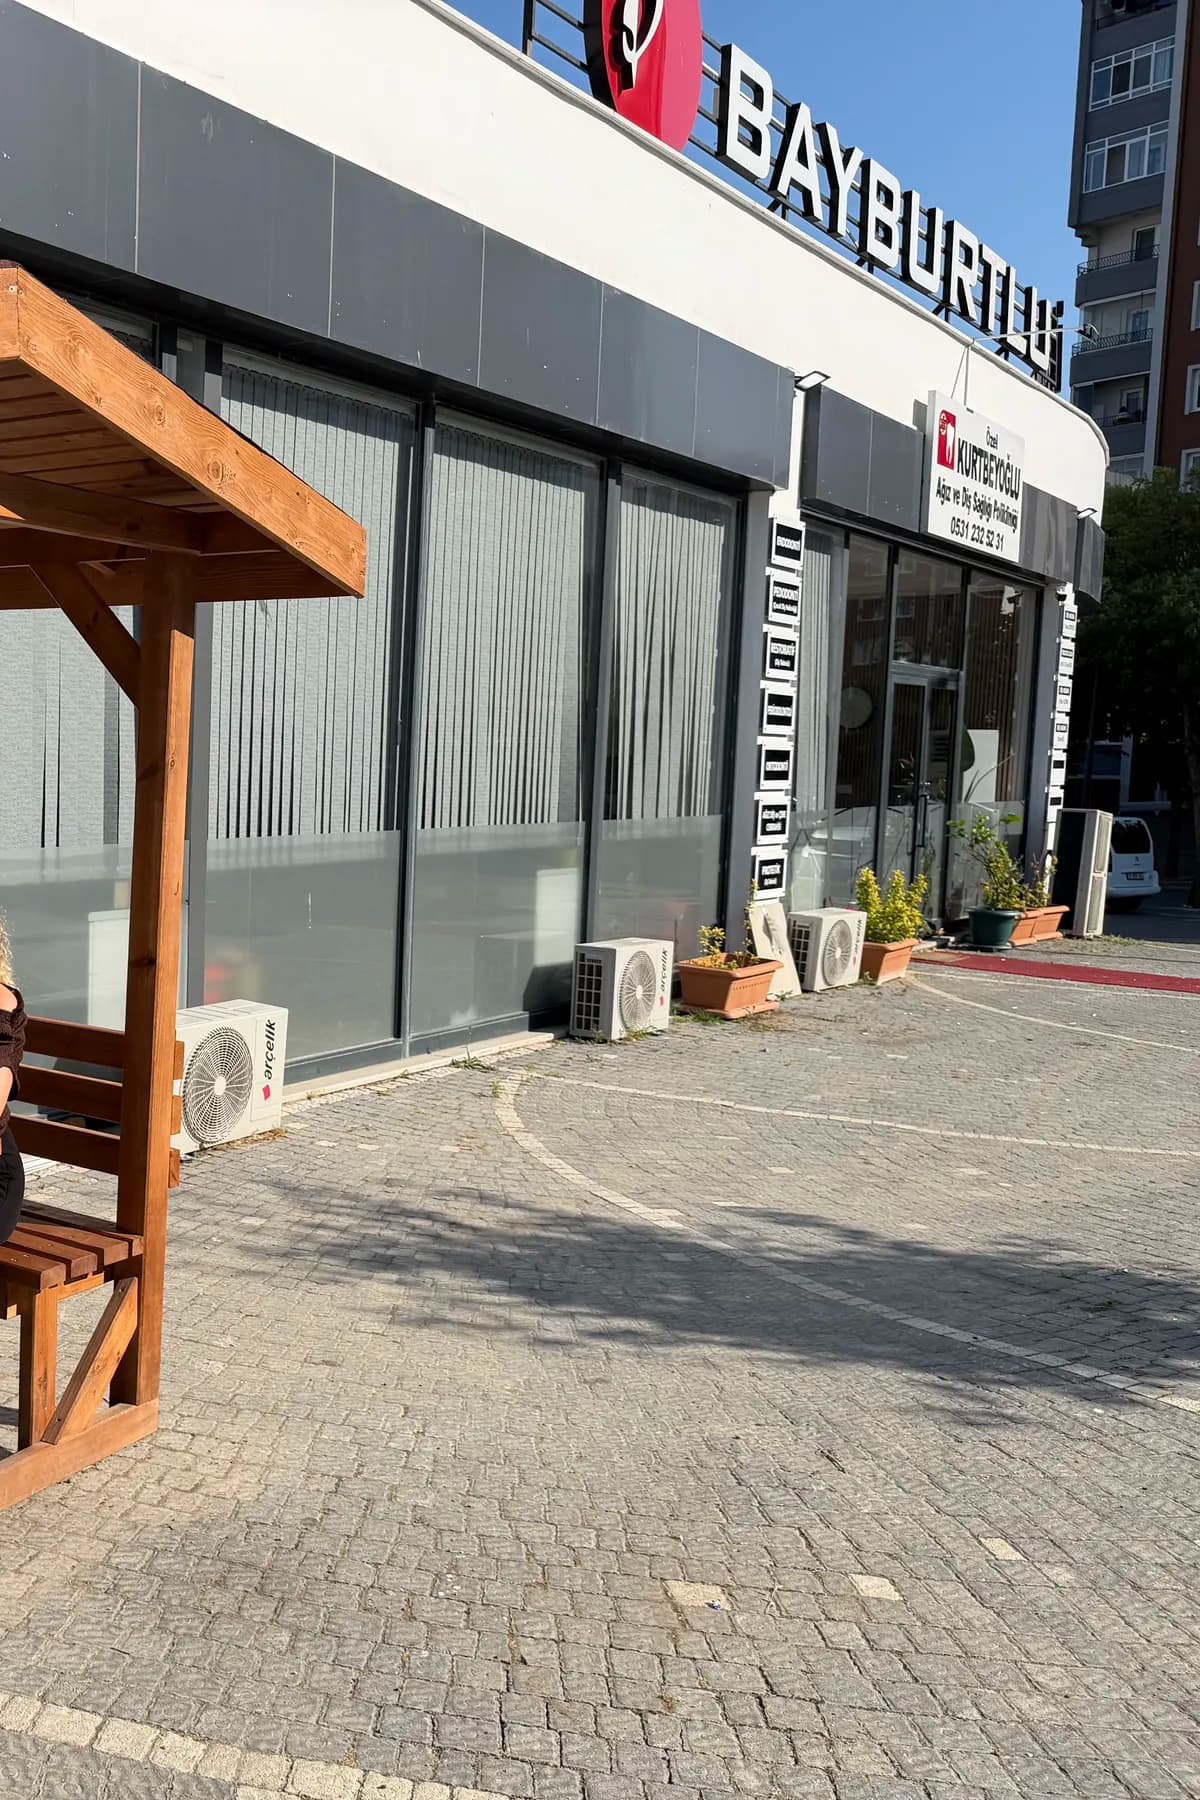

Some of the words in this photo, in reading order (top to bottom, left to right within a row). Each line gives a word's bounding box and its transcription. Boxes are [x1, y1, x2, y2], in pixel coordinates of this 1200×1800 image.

[717, 43, 1052, 373] BAYBURTLU
[985, 426, 998, 449] Özel
[957, 437, 1021, 501] KURTBEYOĞLU
[936, 476, 951, 505] Ağız
[953, 487, 960, 505] ve
[961, 486, 971, 514] Diş
[973, 491, 991, 522] Sağlığı
[950, 516, 969, 539] 0531
[971, 524, 984, 544] 232
[986, 529, 994, 547] 52
[995, 532, 1004, 552] 31
[264, 1019, 275, 1079] arçelik
